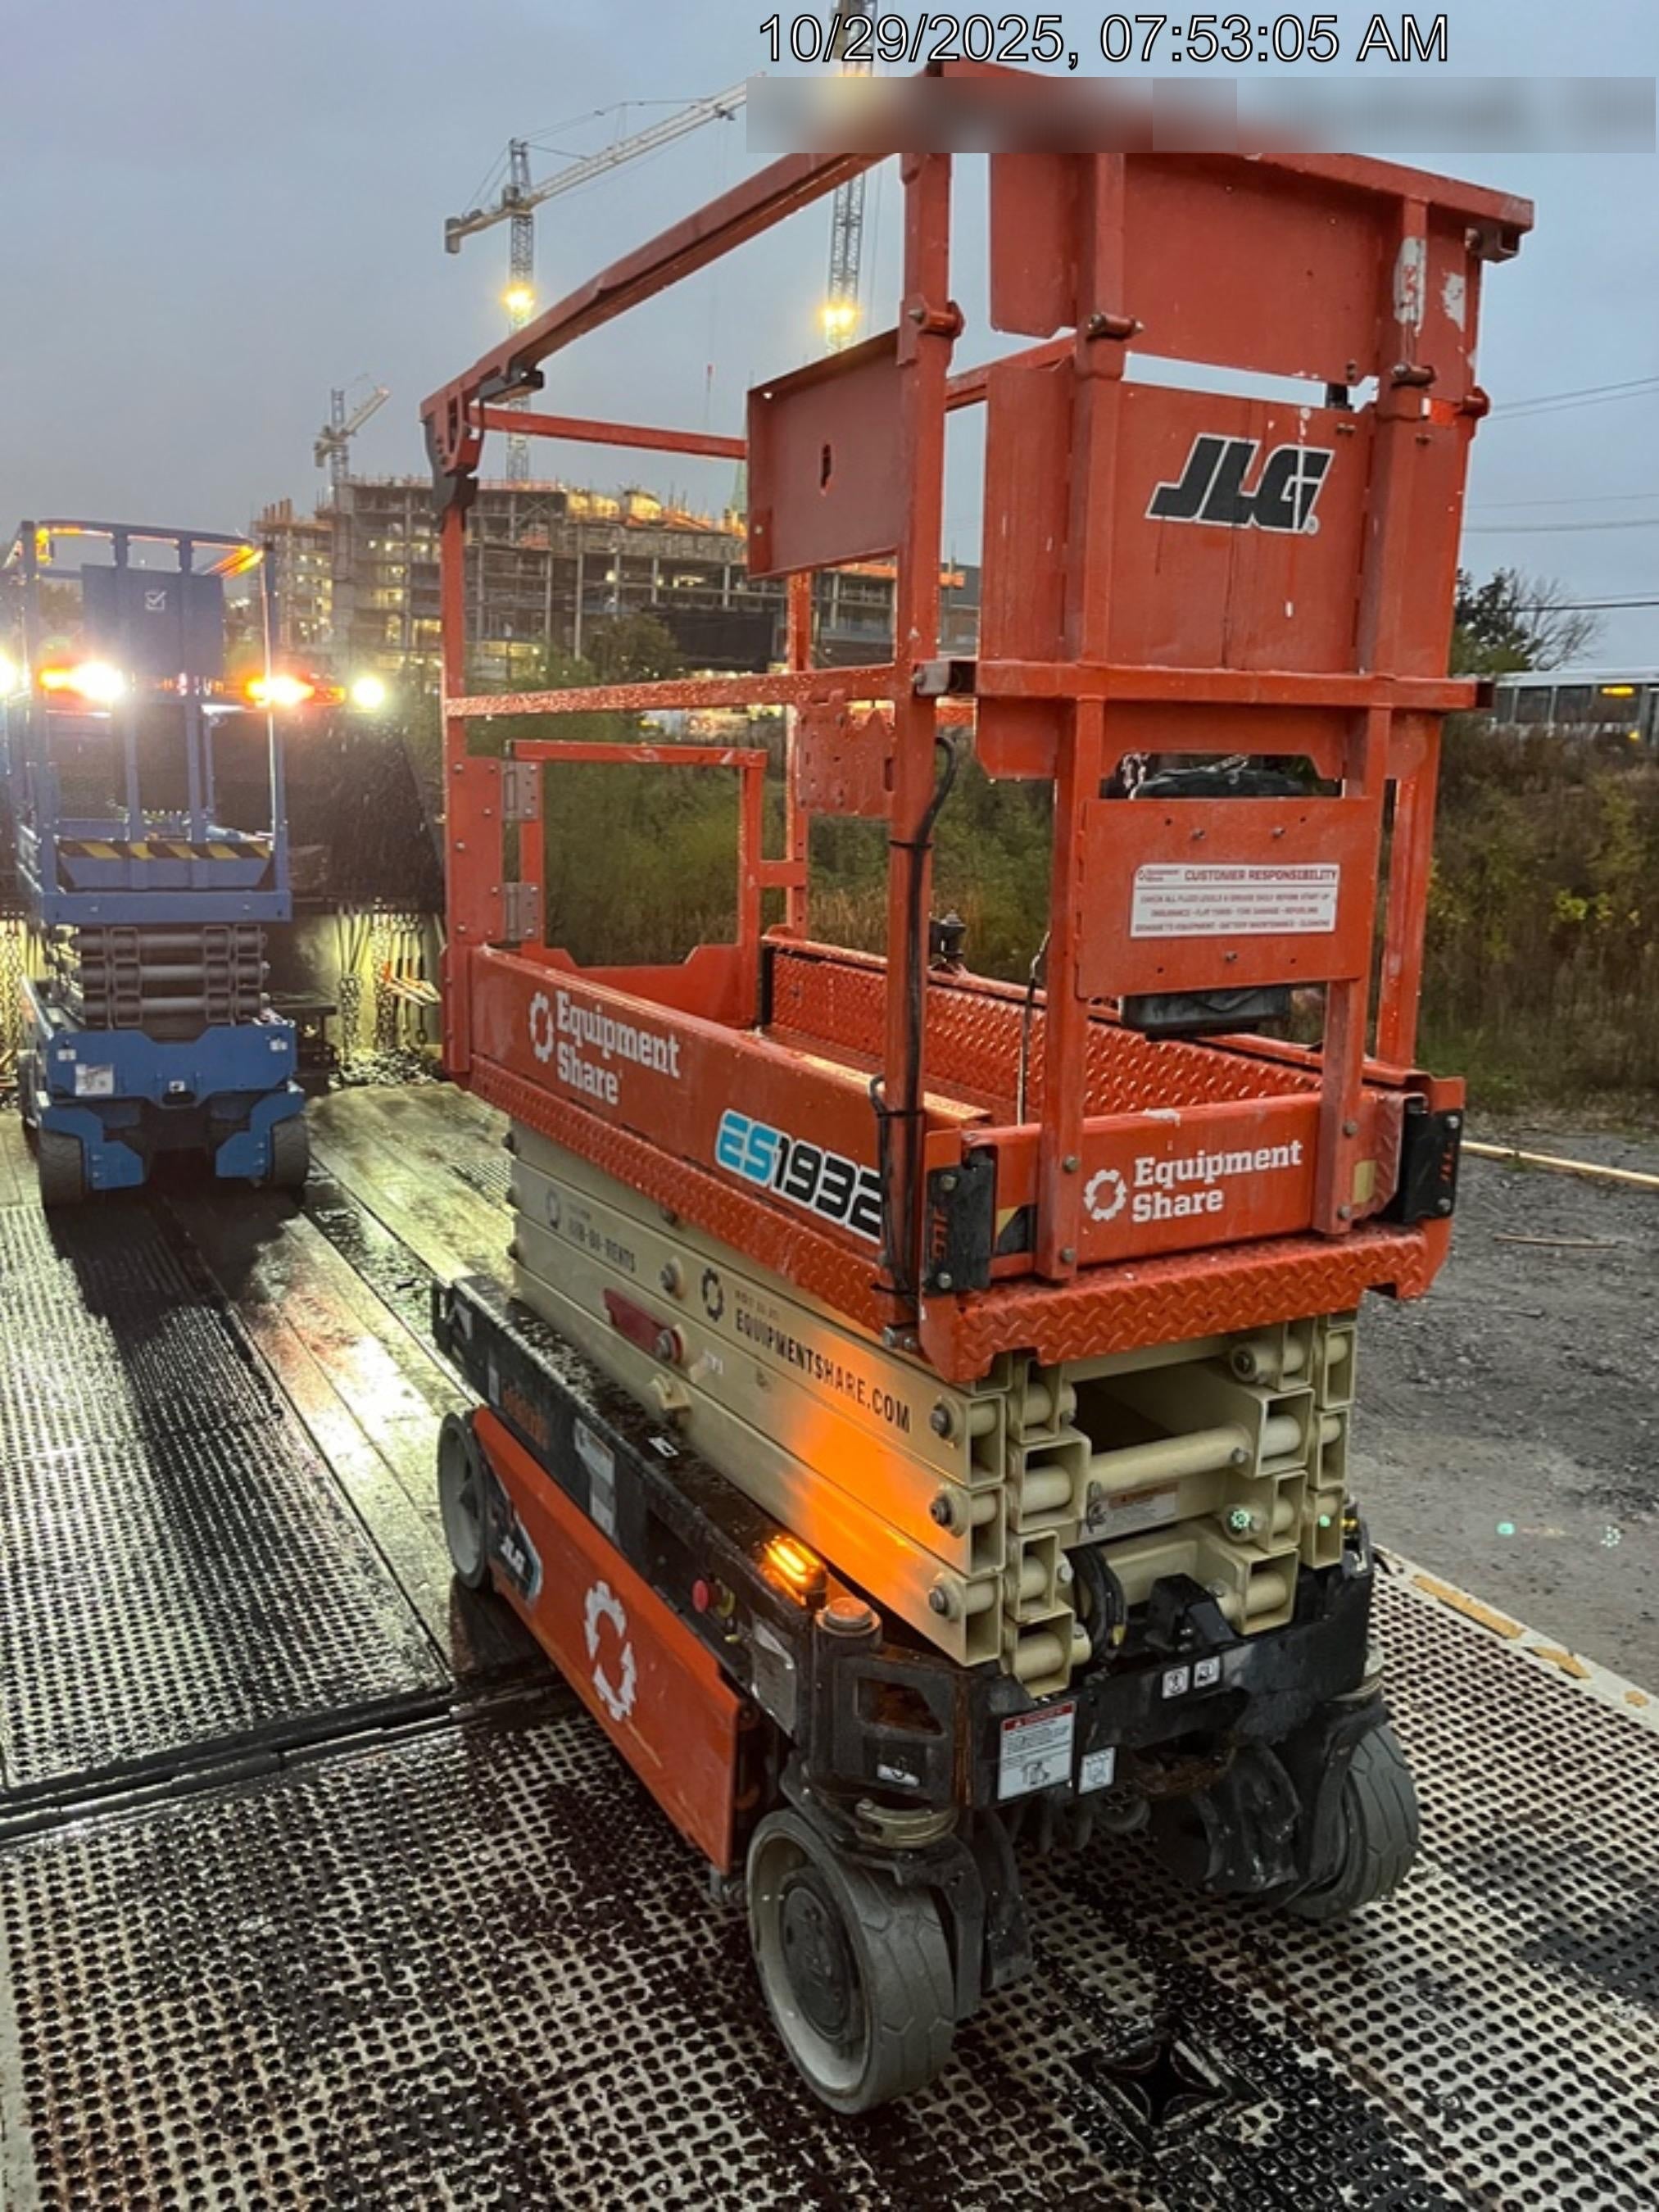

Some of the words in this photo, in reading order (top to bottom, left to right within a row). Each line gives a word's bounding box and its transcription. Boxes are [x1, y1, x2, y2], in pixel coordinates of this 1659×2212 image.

[1145, 433, 1335, 534] JLG
[1185, 869, 1245, 882] CUSTOMER
[1249, 869, 1336, 881] RESPONSIBILITY
[555, 990, 681, 1079] Equipment
[557, 1041, 619, 1105] Share
[716, 1109, 881, 1244] ES1932
[1134, 1140, 1303, 1189] Equipment
[1132, 1190, 1223, 1223] Share
[736, 1308, 911, 1435] EQUIPMENTSHARE.COM
